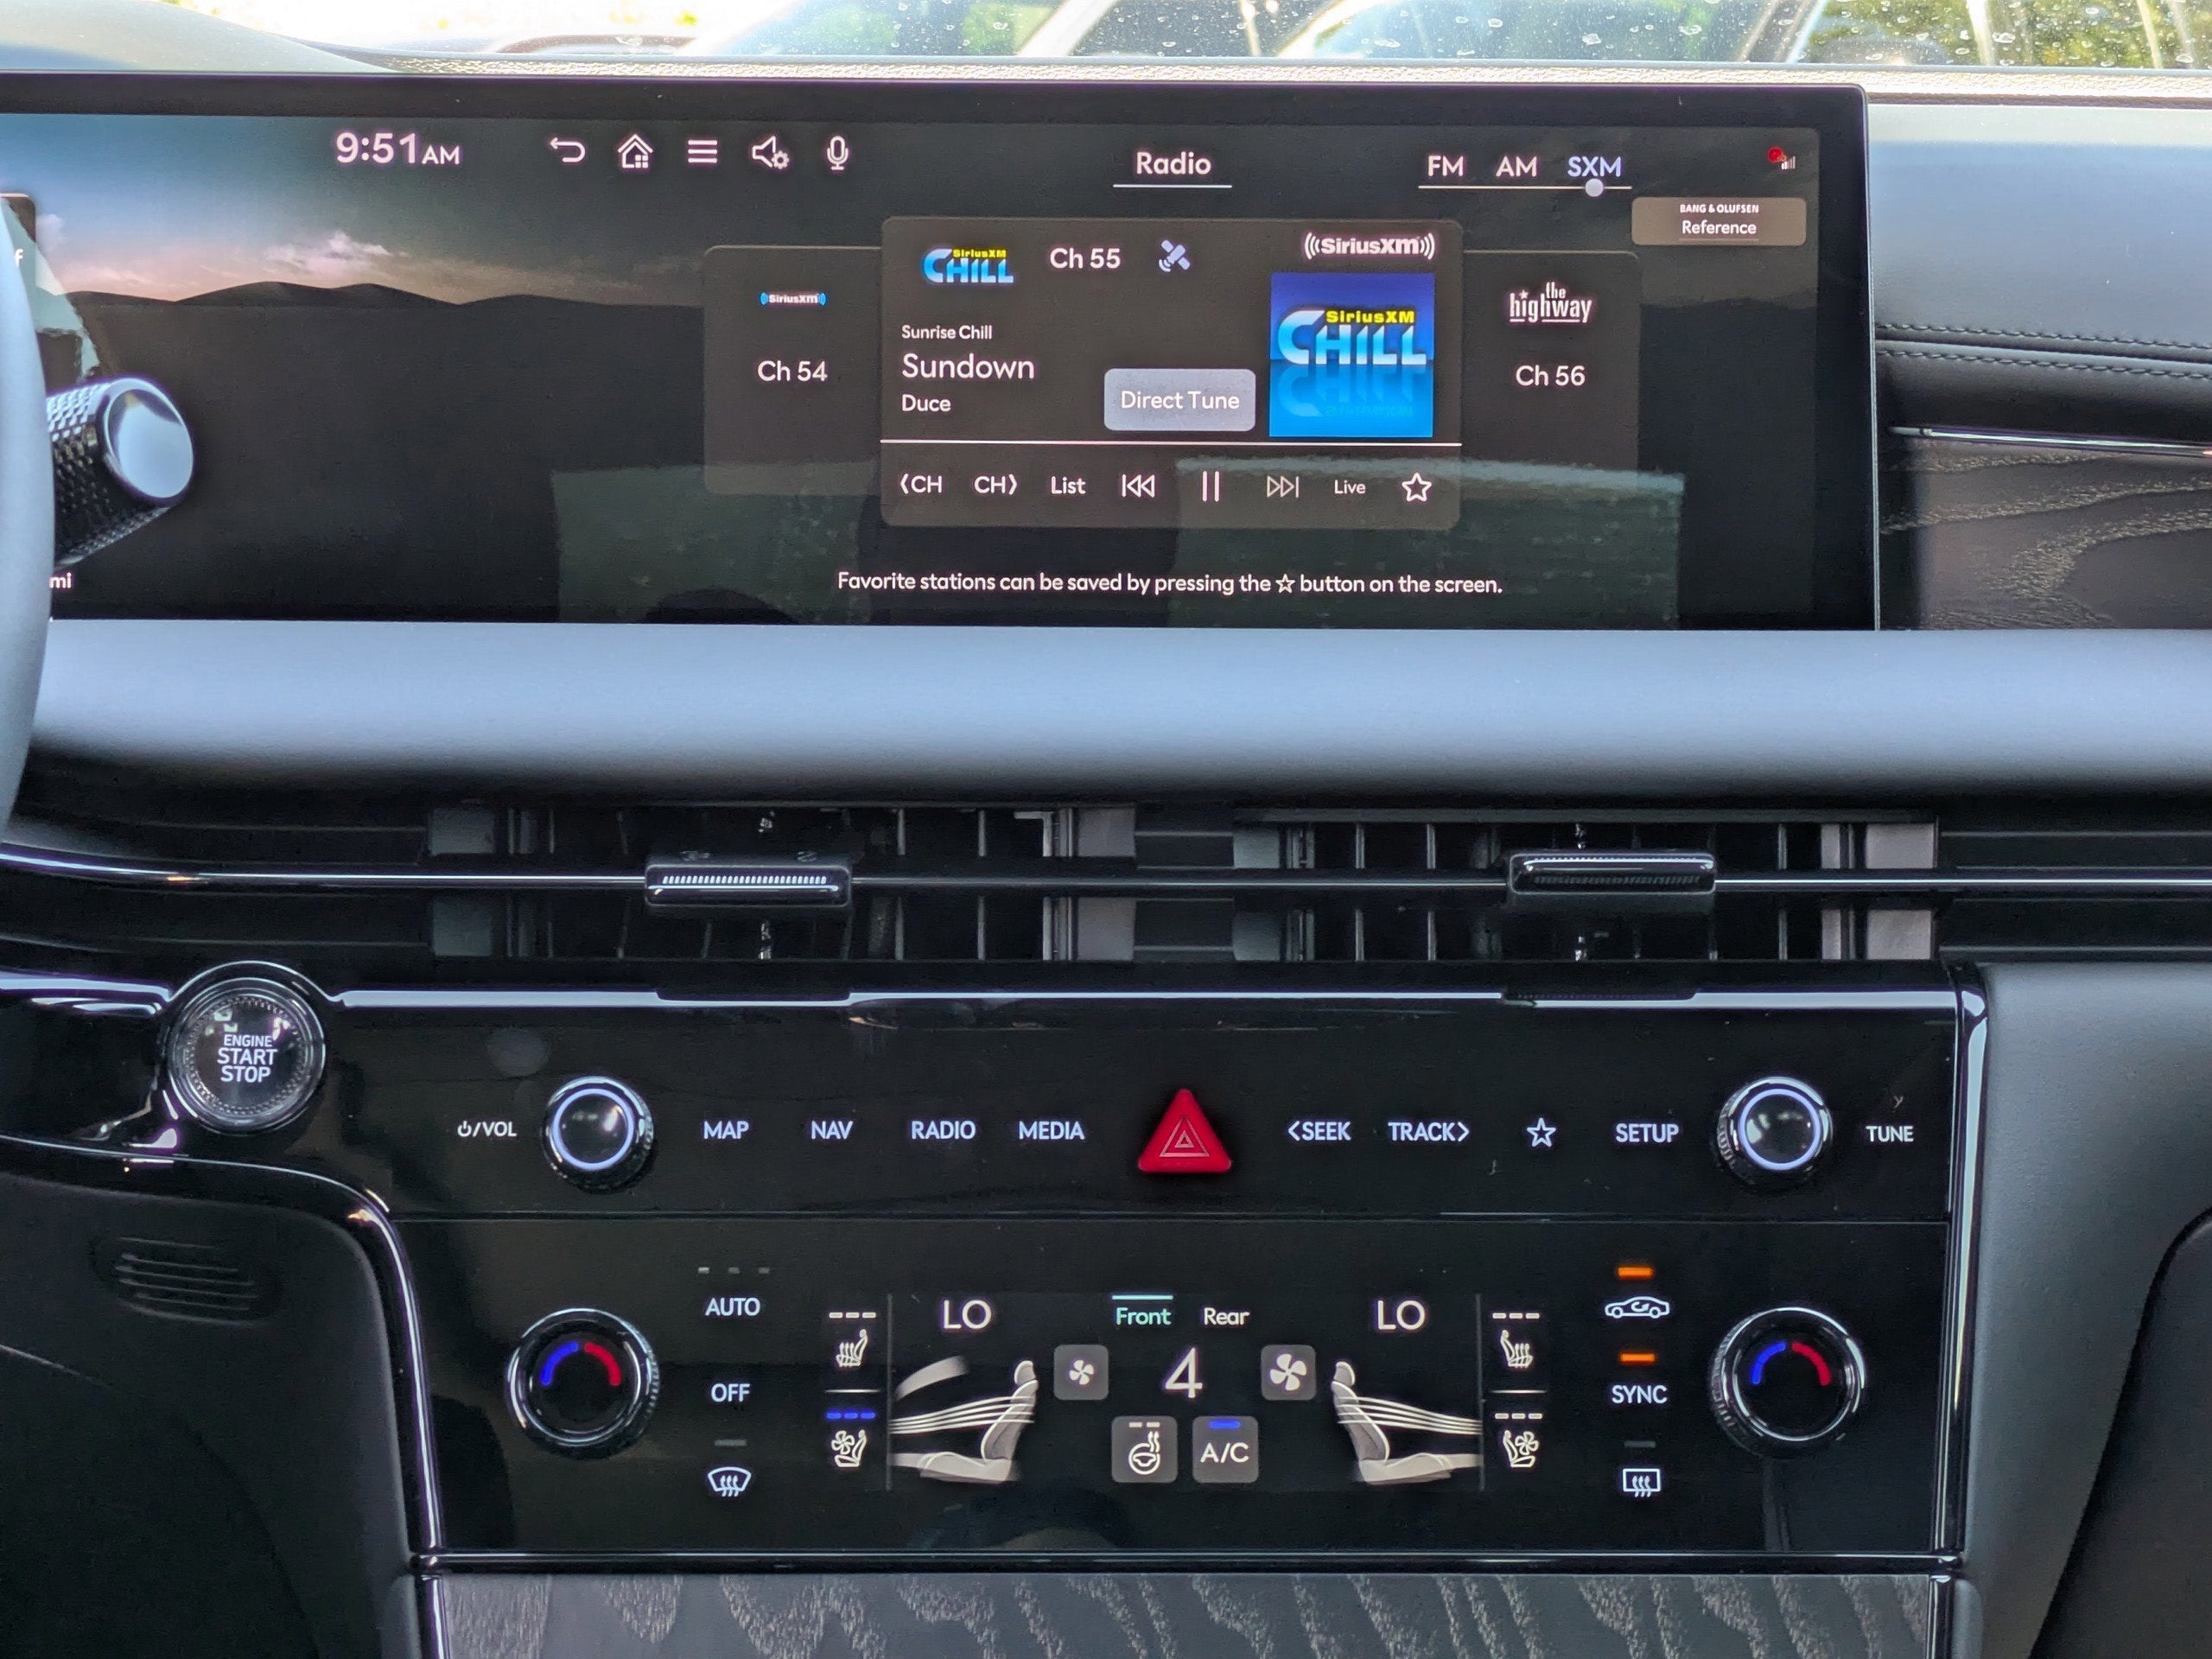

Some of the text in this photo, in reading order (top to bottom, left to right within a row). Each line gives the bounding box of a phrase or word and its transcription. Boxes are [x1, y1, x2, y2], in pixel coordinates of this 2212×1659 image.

[1136, 151, 1211, 175] Radio
[1427, 155, 1464, 177] FM
[1496, 156, 1537, 177] AM
[1567, 156, 1622, 177] SXM
[1680, 203, 1759, 213] BANG & OLUFSEN
[1681, 219, 1758, 235] Reference
[952, 248, 1007, 258] SiriusXM
[1050, 247, 1121, 269] Ch 55
[921, 247, 1016, 284] CHILL
[1545, 281, 1567, 299] the
[1325, 310, 1416, 324] SiriusXM
[1509, 292, 1593, 324] highway
[901, 324, 993, 340] Sunrise Chill
[1277, 309, 1427, 365] CHILL
[757, 359, 828, 382] Ch 54
[902, 353, 1034, 379] Sundown
[1516, 364, 1586, 386] Ch 56
[901, 393, 951, 412] Duce
[1120, 389, 1241, 412] Direct Tune
[1051, 475, 1086, 494] List
[1334, 480, 1366, 494] Live
[838, 571, 1503, 596] Favorite stations can be saved by pressing the button on the screen.
[224, 1034, 272, 1046] ENGINE
[218, 1048, 277, 1064] START
[220, 1066, 270, 1082] STOP
[703, 1120, 749, 1140] MAP
[810, 1120, 854, 1140] NAV
[911, 1120, 976, 1140] RADIO
[1019, 1121, 1085, 1141] MEDIA
[1615, 1122, 1679, 1143] SETUP
[1866, 1125, 1914, 1142] TUNE
[705, 1297, 761, 1316] AUTO
[943, 1300, 992, 1330] LO
[1116, 1306, 1172, 1325] Front
[1204, 1306, 1250, 1325] Rear
[1377, 1300, 1426, 1331] LO
[1164, 1347, 1204, 1399] 4
[710, 1382, 751, 1402] OFF
[1611, 1384, 1668, 1404] SYNC
[1200, 1442, 1249, 1464] A/C
